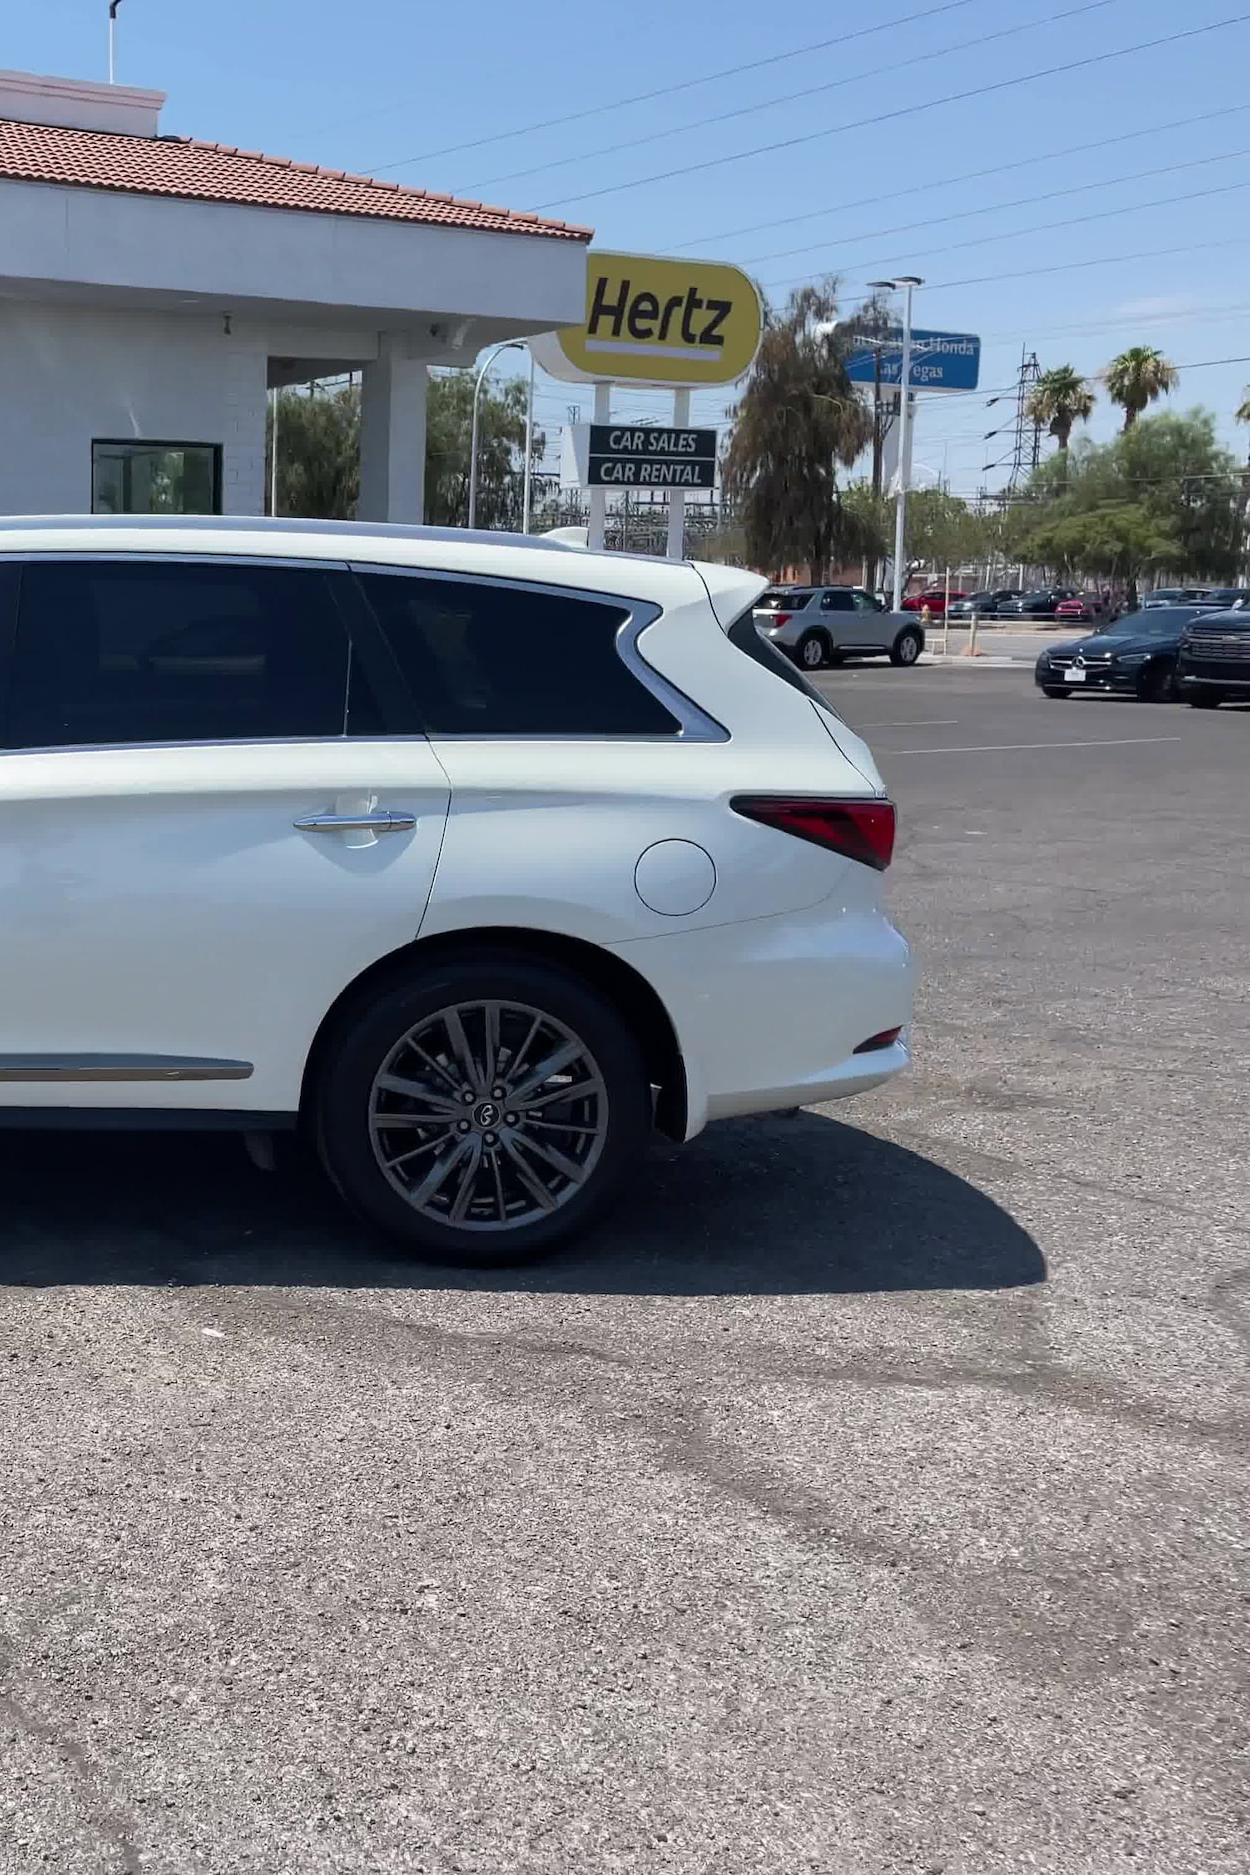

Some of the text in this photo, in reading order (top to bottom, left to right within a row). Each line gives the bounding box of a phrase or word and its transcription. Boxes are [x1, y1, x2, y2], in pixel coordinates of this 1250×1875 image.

[587, 277, 732, 346] Hertz
[930, 337, 974, 355] Honda
[609, 430, 698, 452] CAR SALES
[600, 462, 702, 484] CAR RENTAL
